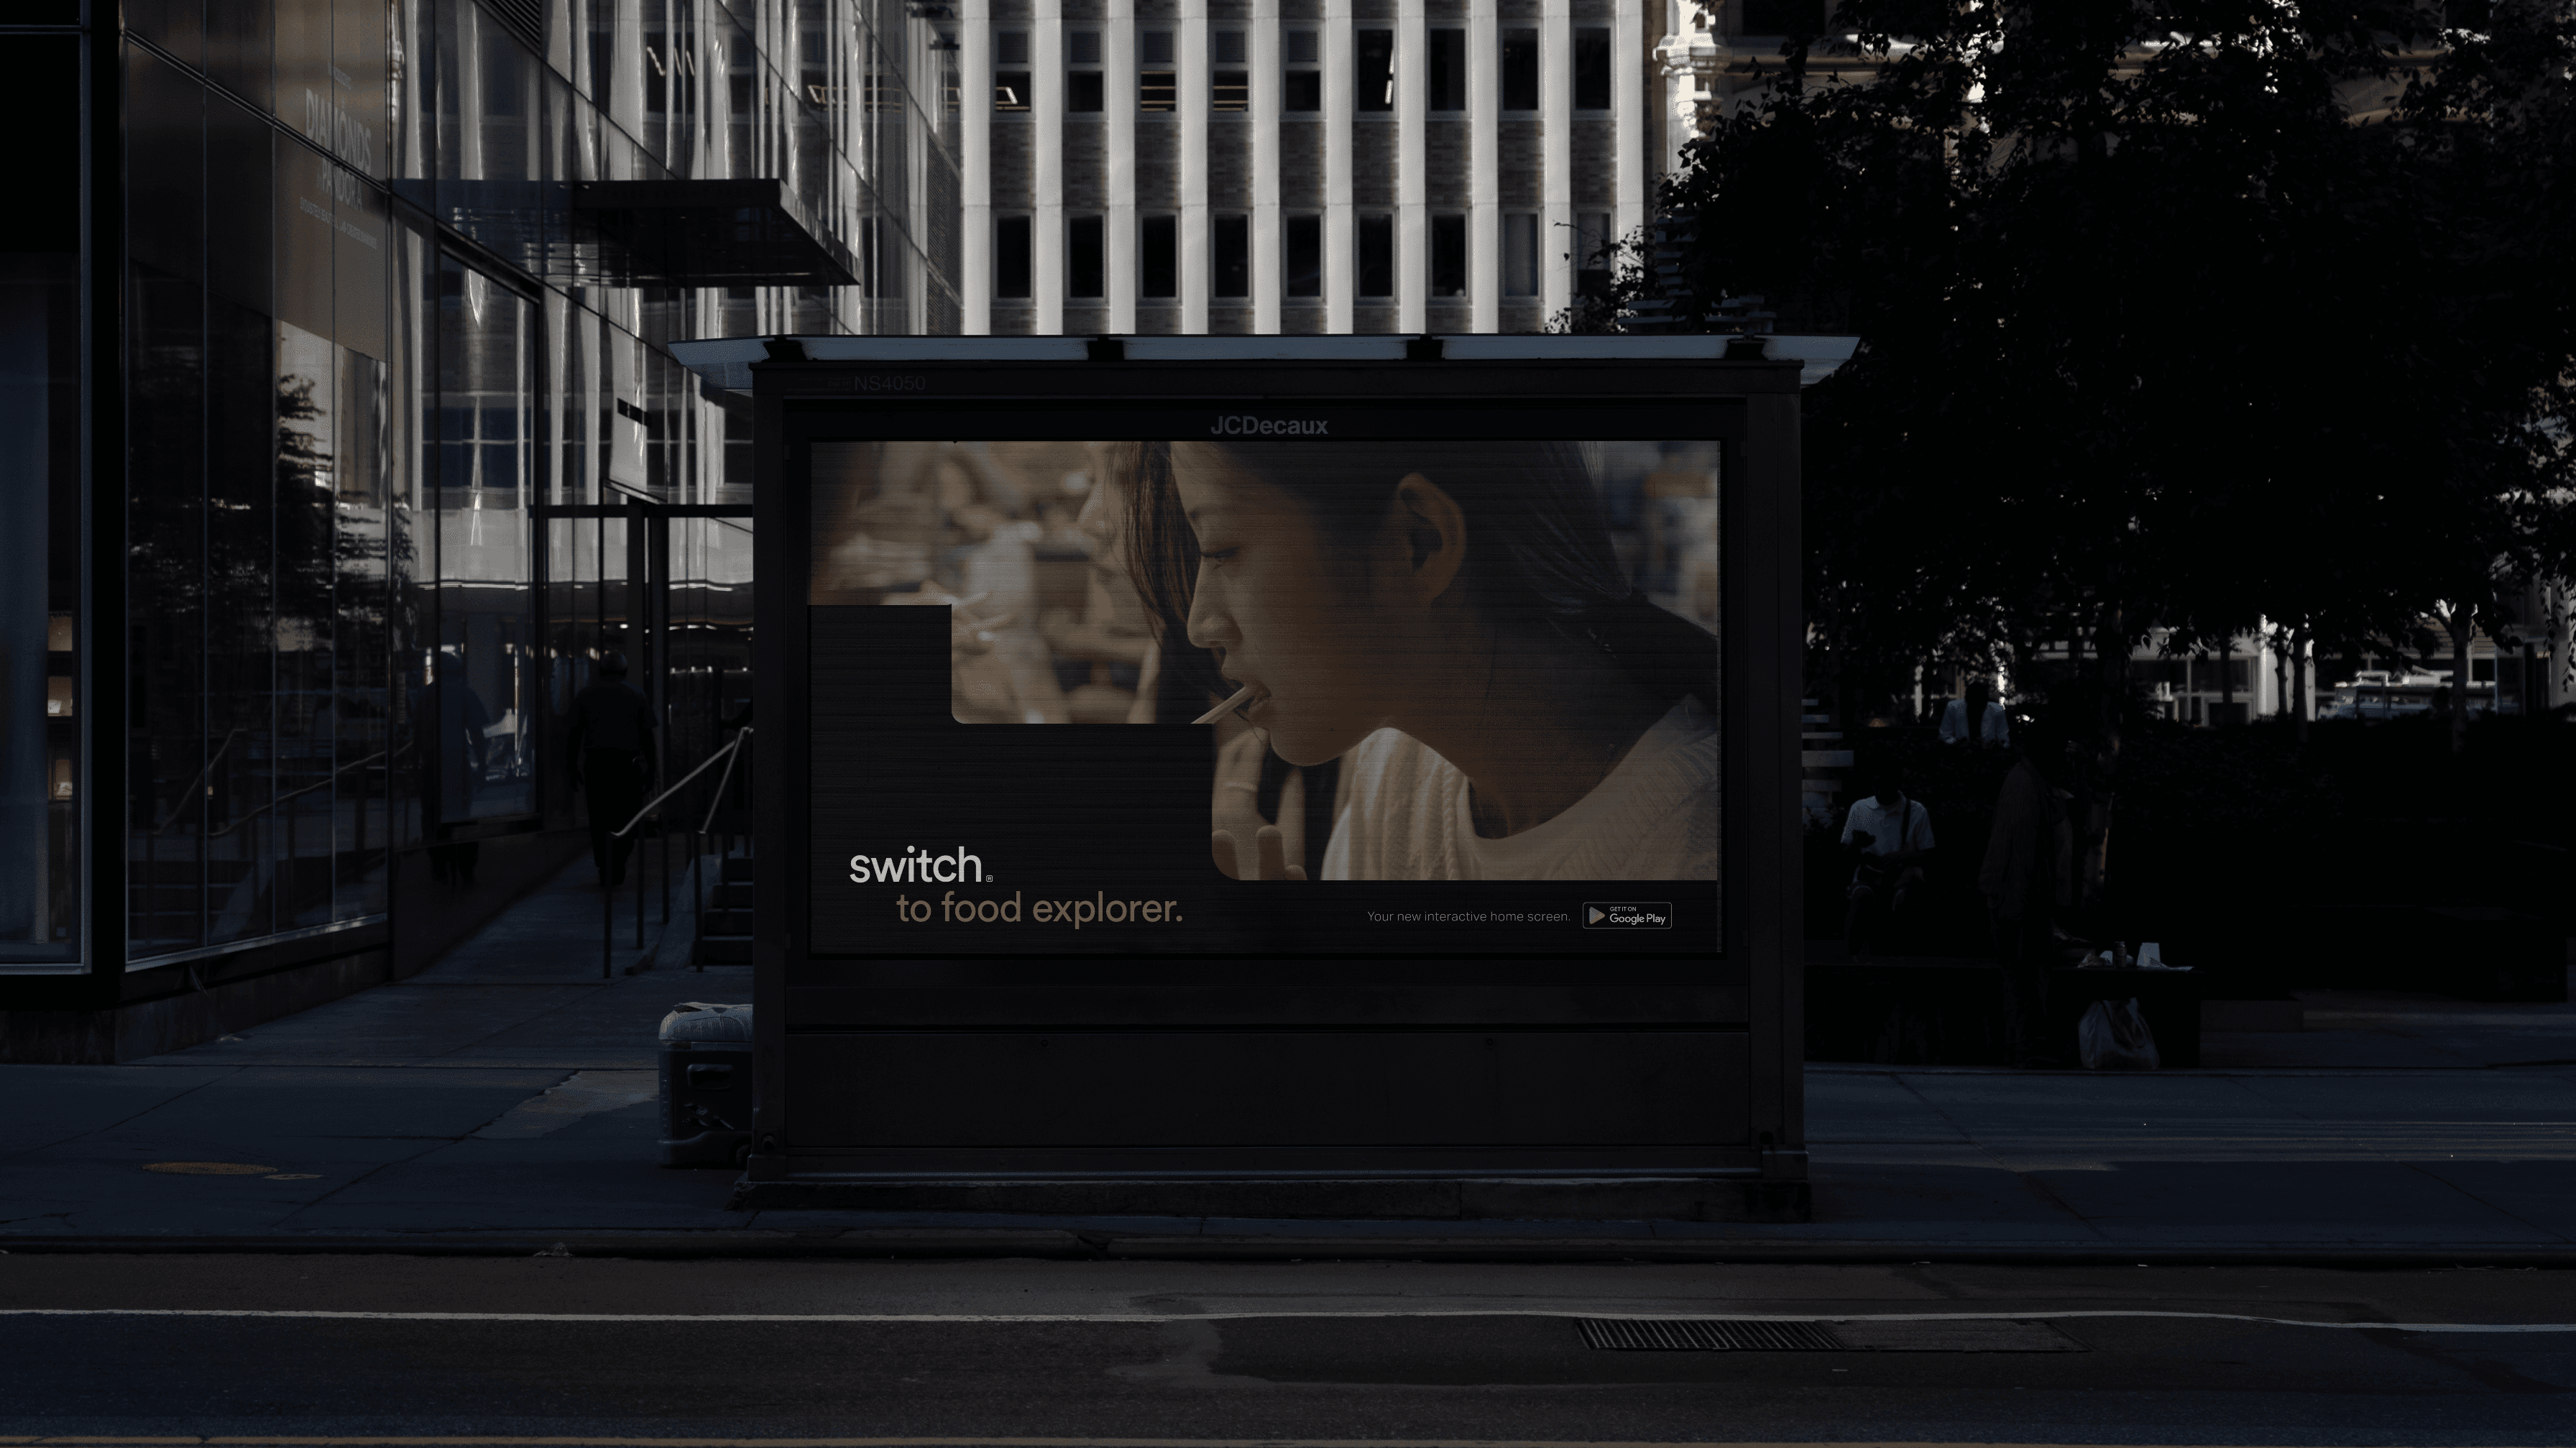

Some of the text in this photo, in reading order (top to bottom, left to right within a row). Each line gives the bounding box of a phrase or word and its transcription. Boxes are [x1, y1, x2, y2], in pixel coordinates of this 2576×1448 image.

[305, 88, 372, 177] DIAMONDS
[855, 375, 926, 391] NS4050
[1210, 415, 1329, 435] JCDecaux
[896, 890, 1183, 930] to food explorer.
[1367, 910, 1571, 922] Your new interactive home screen.
[1609, 913, 1666, 926] Google Play
